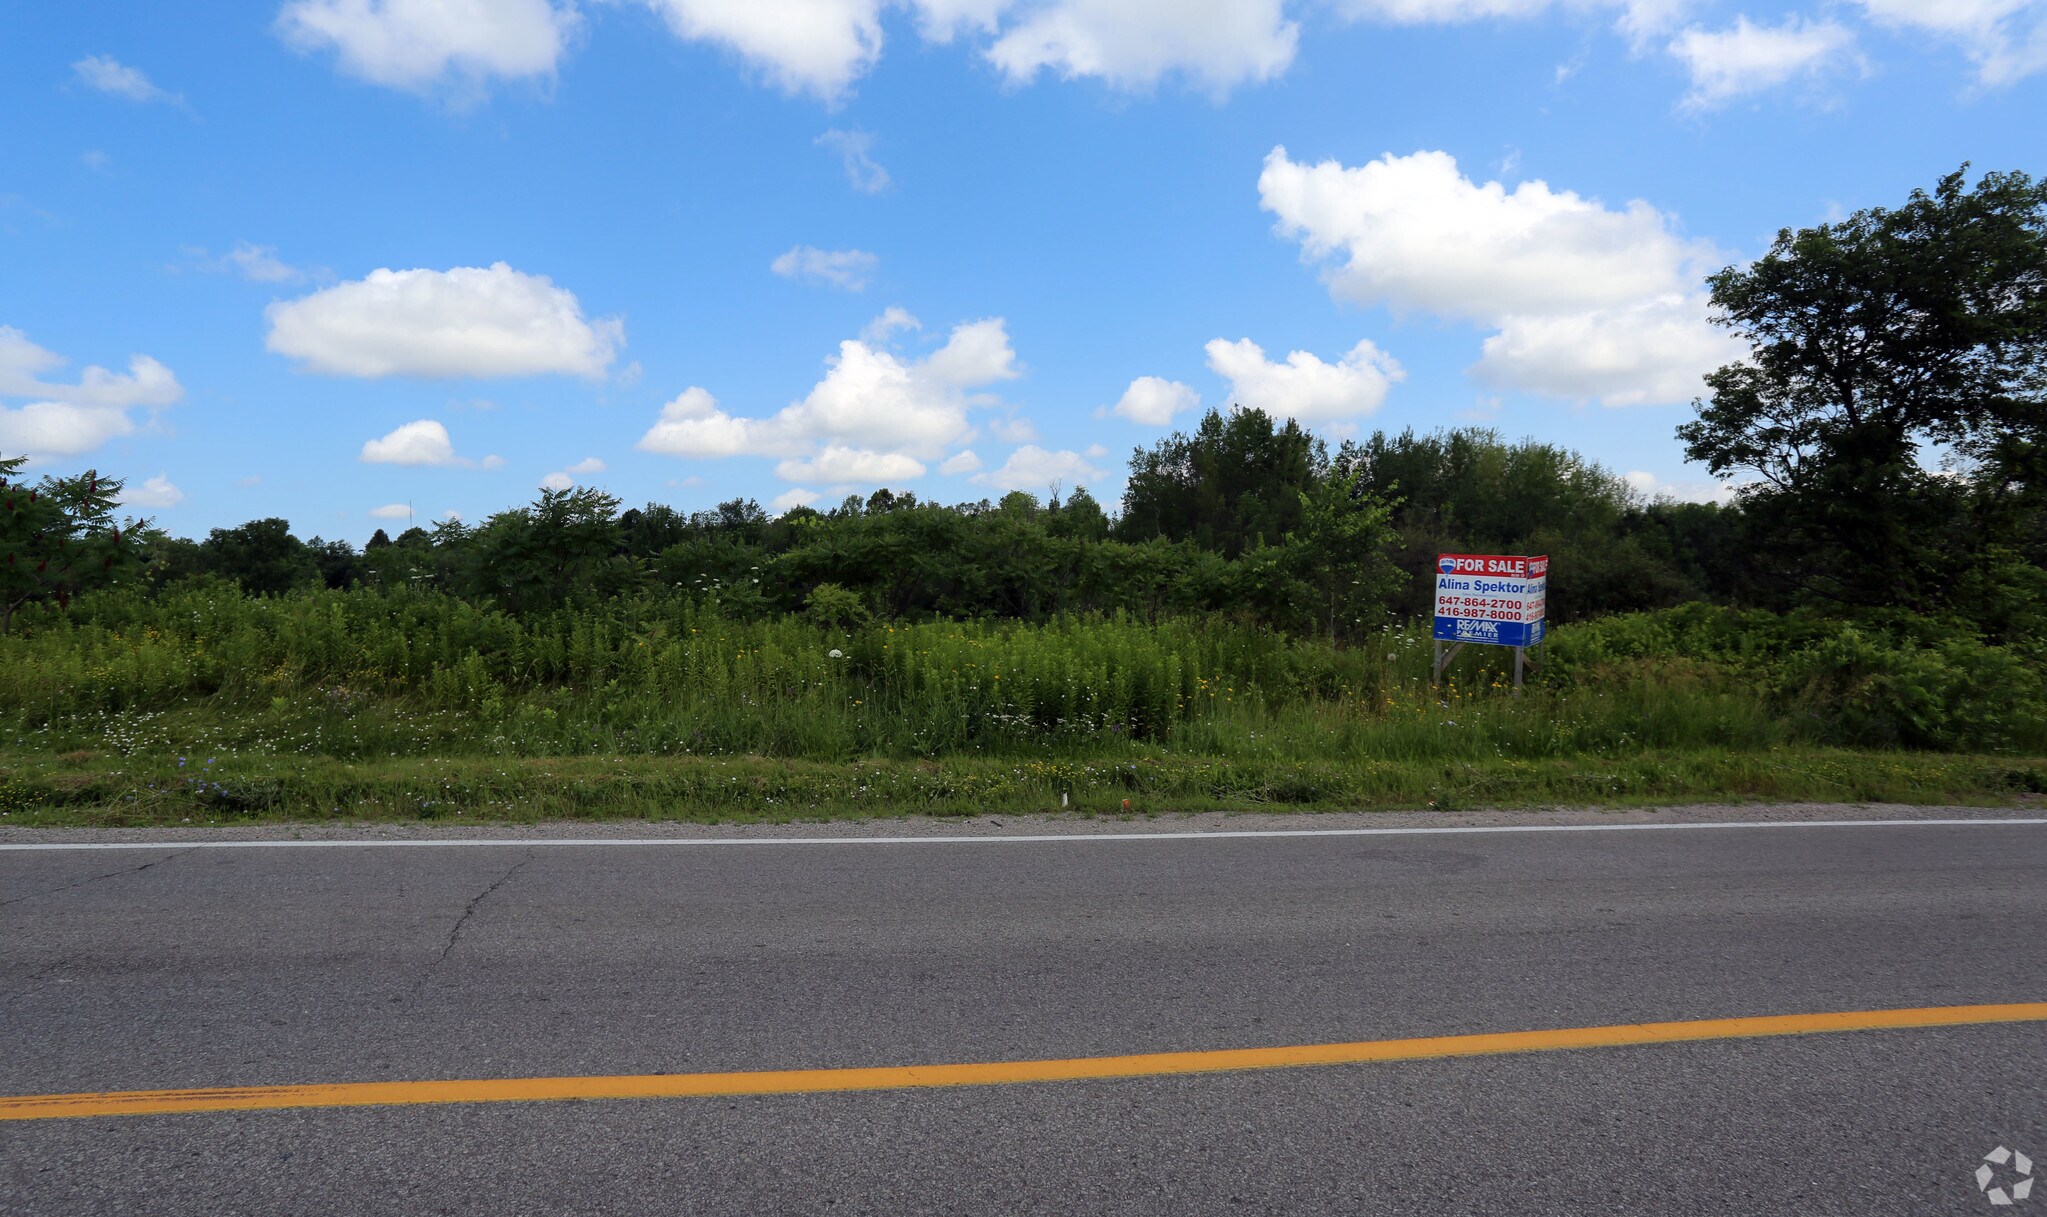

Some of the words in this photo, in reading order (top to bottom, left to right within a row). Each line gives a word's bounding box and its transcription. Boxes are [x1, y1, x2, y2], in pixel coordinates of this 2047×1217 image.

[1456, 558, 1484, 572] FOR
[1488, 560, 1525, 574] SALE
[1438, 578, 1470, 590] Alina
[1474, 580, 1526, 594] Spektor
[1438, 596, 1522, 610] 647-864-2700
[1438, 606, 1522, 621] 416-987-8000
[1456, 619, 1499, 632] RE/MAX
